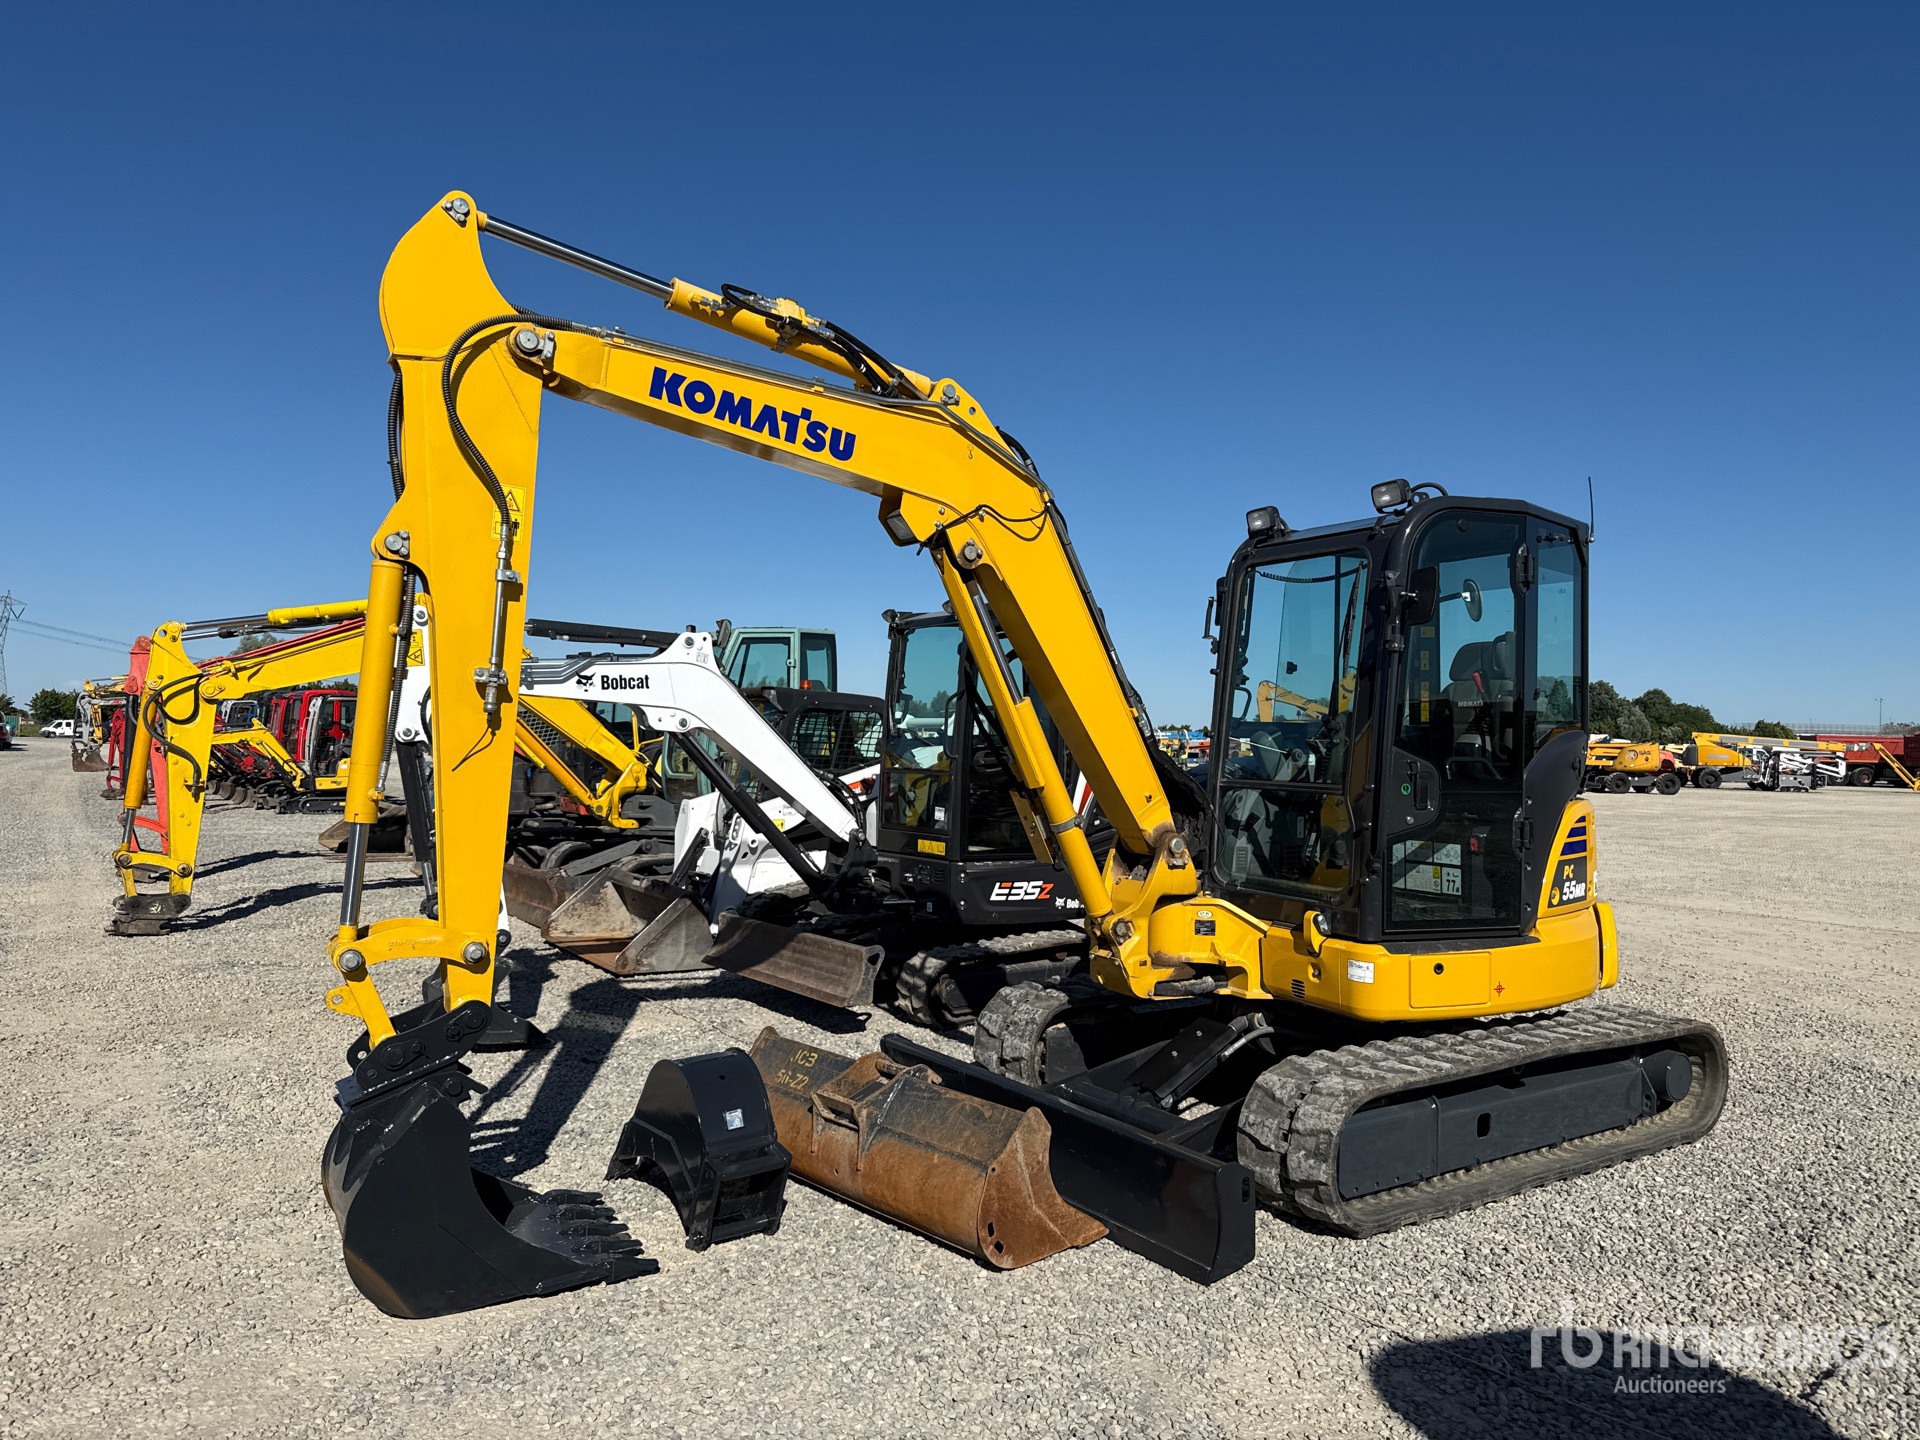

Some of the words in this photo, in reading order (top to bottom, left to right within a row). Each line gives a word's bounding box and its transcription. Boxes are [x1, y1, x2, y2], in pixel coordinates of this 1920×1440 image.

[649, 366, 857, 461] KOMATSU
[601, 674, 650, 690] Bobcat
[1563, 864, 1575, 880] PC
[1562, 880, 1586, 901] 55MR
